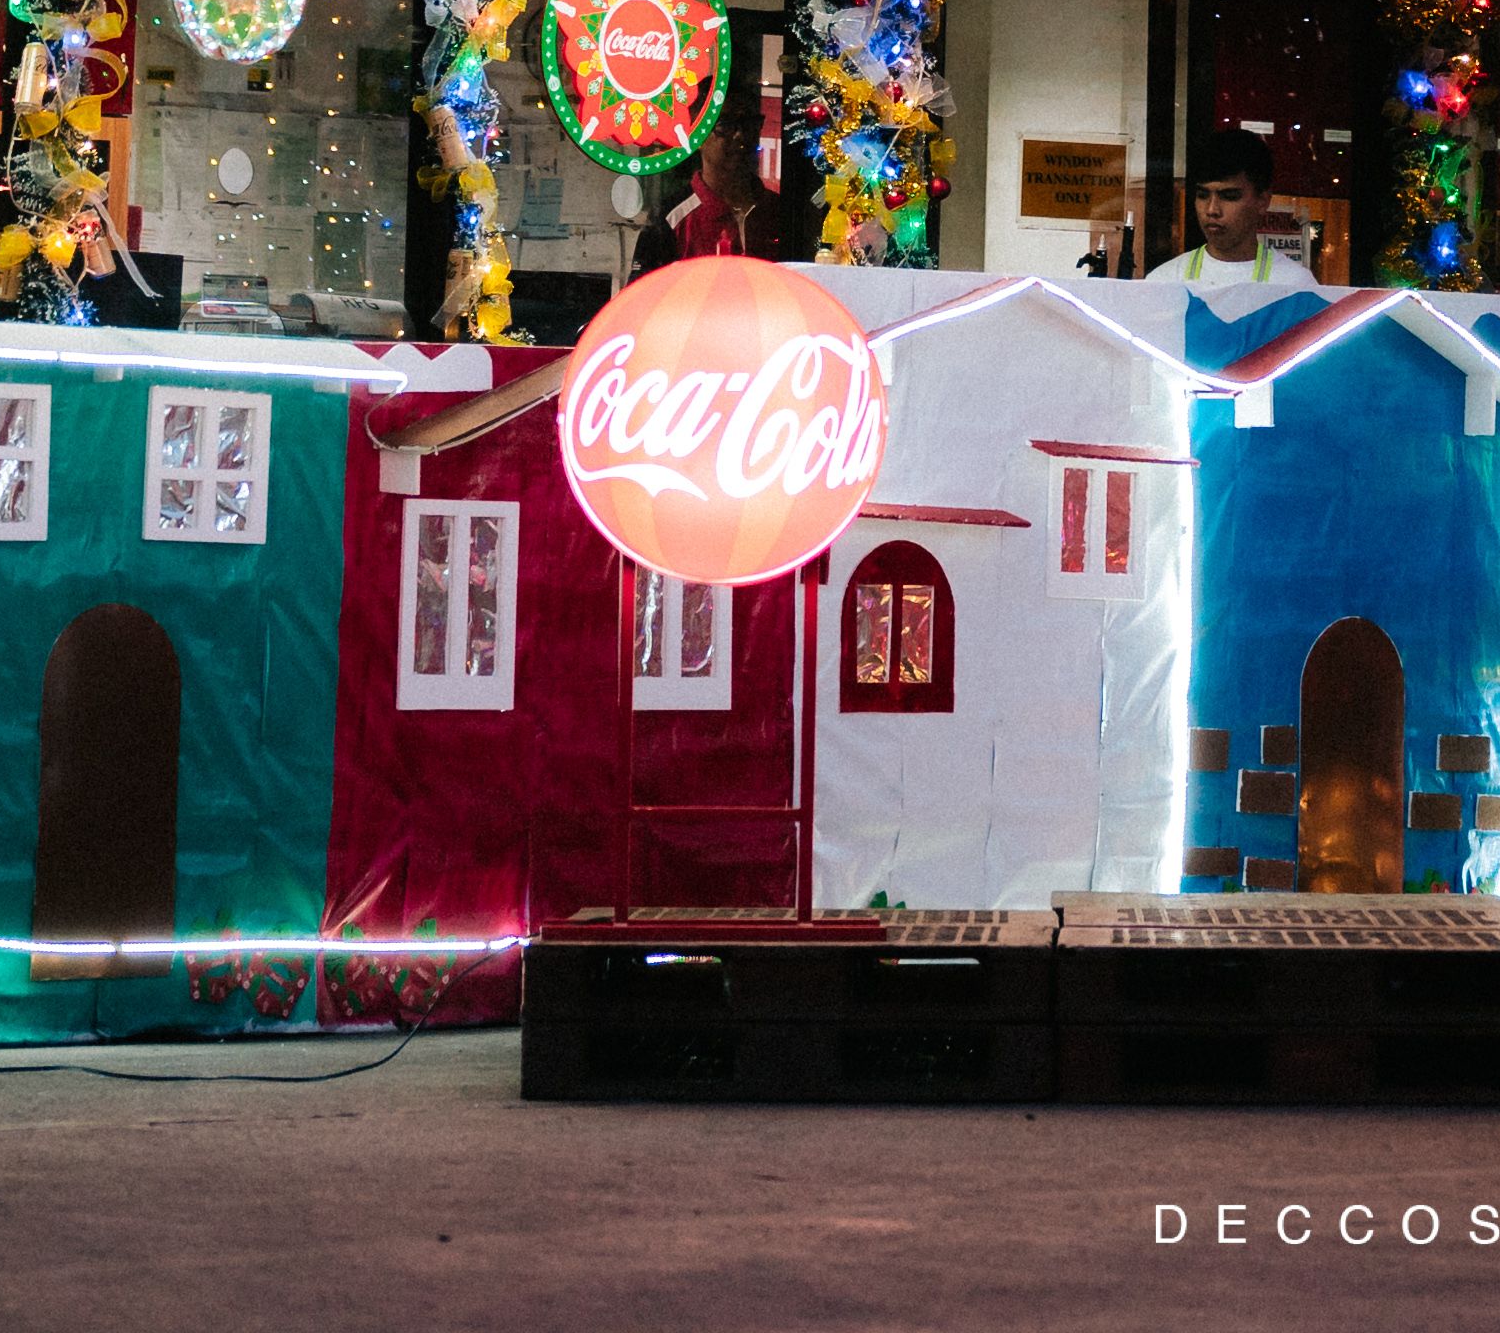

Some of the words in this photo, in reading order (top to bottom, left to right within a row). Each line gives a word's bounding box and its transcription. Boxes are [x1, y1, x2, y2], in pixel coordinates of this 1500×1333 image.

[604, 27, 675, 61] Coca-Cola
[1044, 153, 1105, 169] WINDOW
[1027, 171, 1123, 187] TRANSACTION
[1055, 191, 1092, 205] ONLY
[1267, 237, 1301, 251] PLEASE
[564, 333, 881, 502] Coca-Cola
